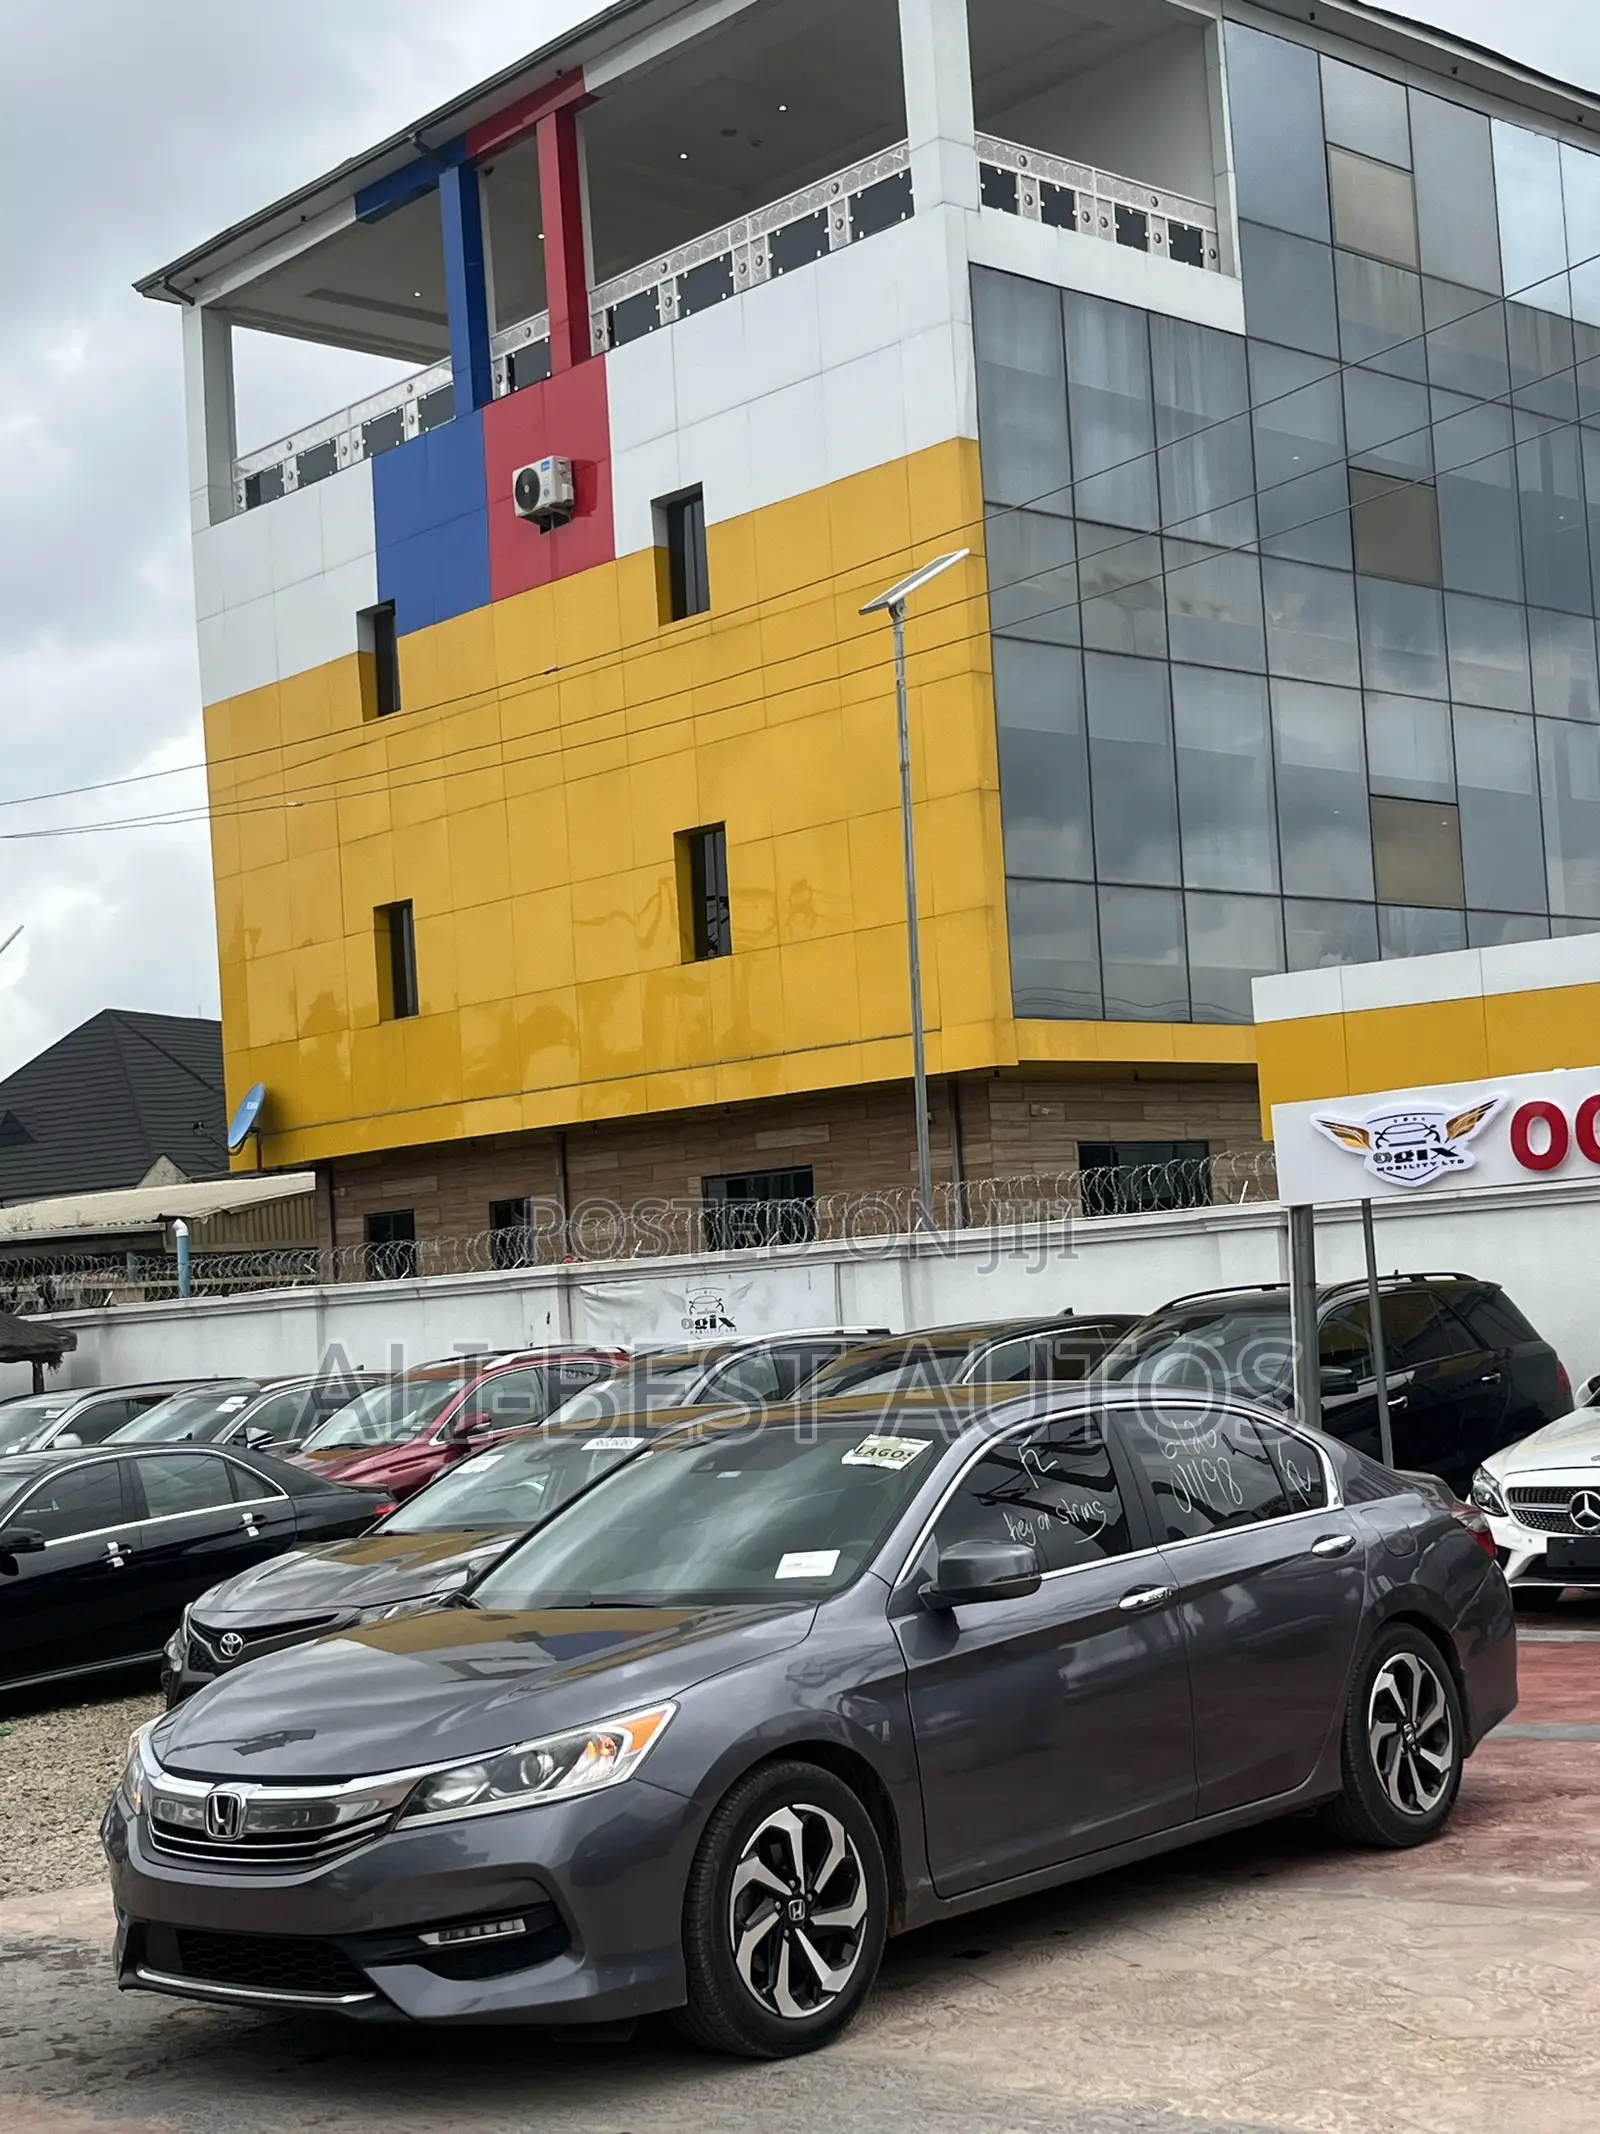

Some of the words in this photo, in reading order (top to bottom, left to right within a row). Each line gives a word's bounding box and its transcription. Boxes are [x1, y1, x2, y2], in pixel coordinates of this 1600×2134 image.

[1376, 1161, 1437, 1173] MOBILITY
[1441, 1158, 1465, 1167] LTD
[855, 1445, 915, 1460] LAGOS
